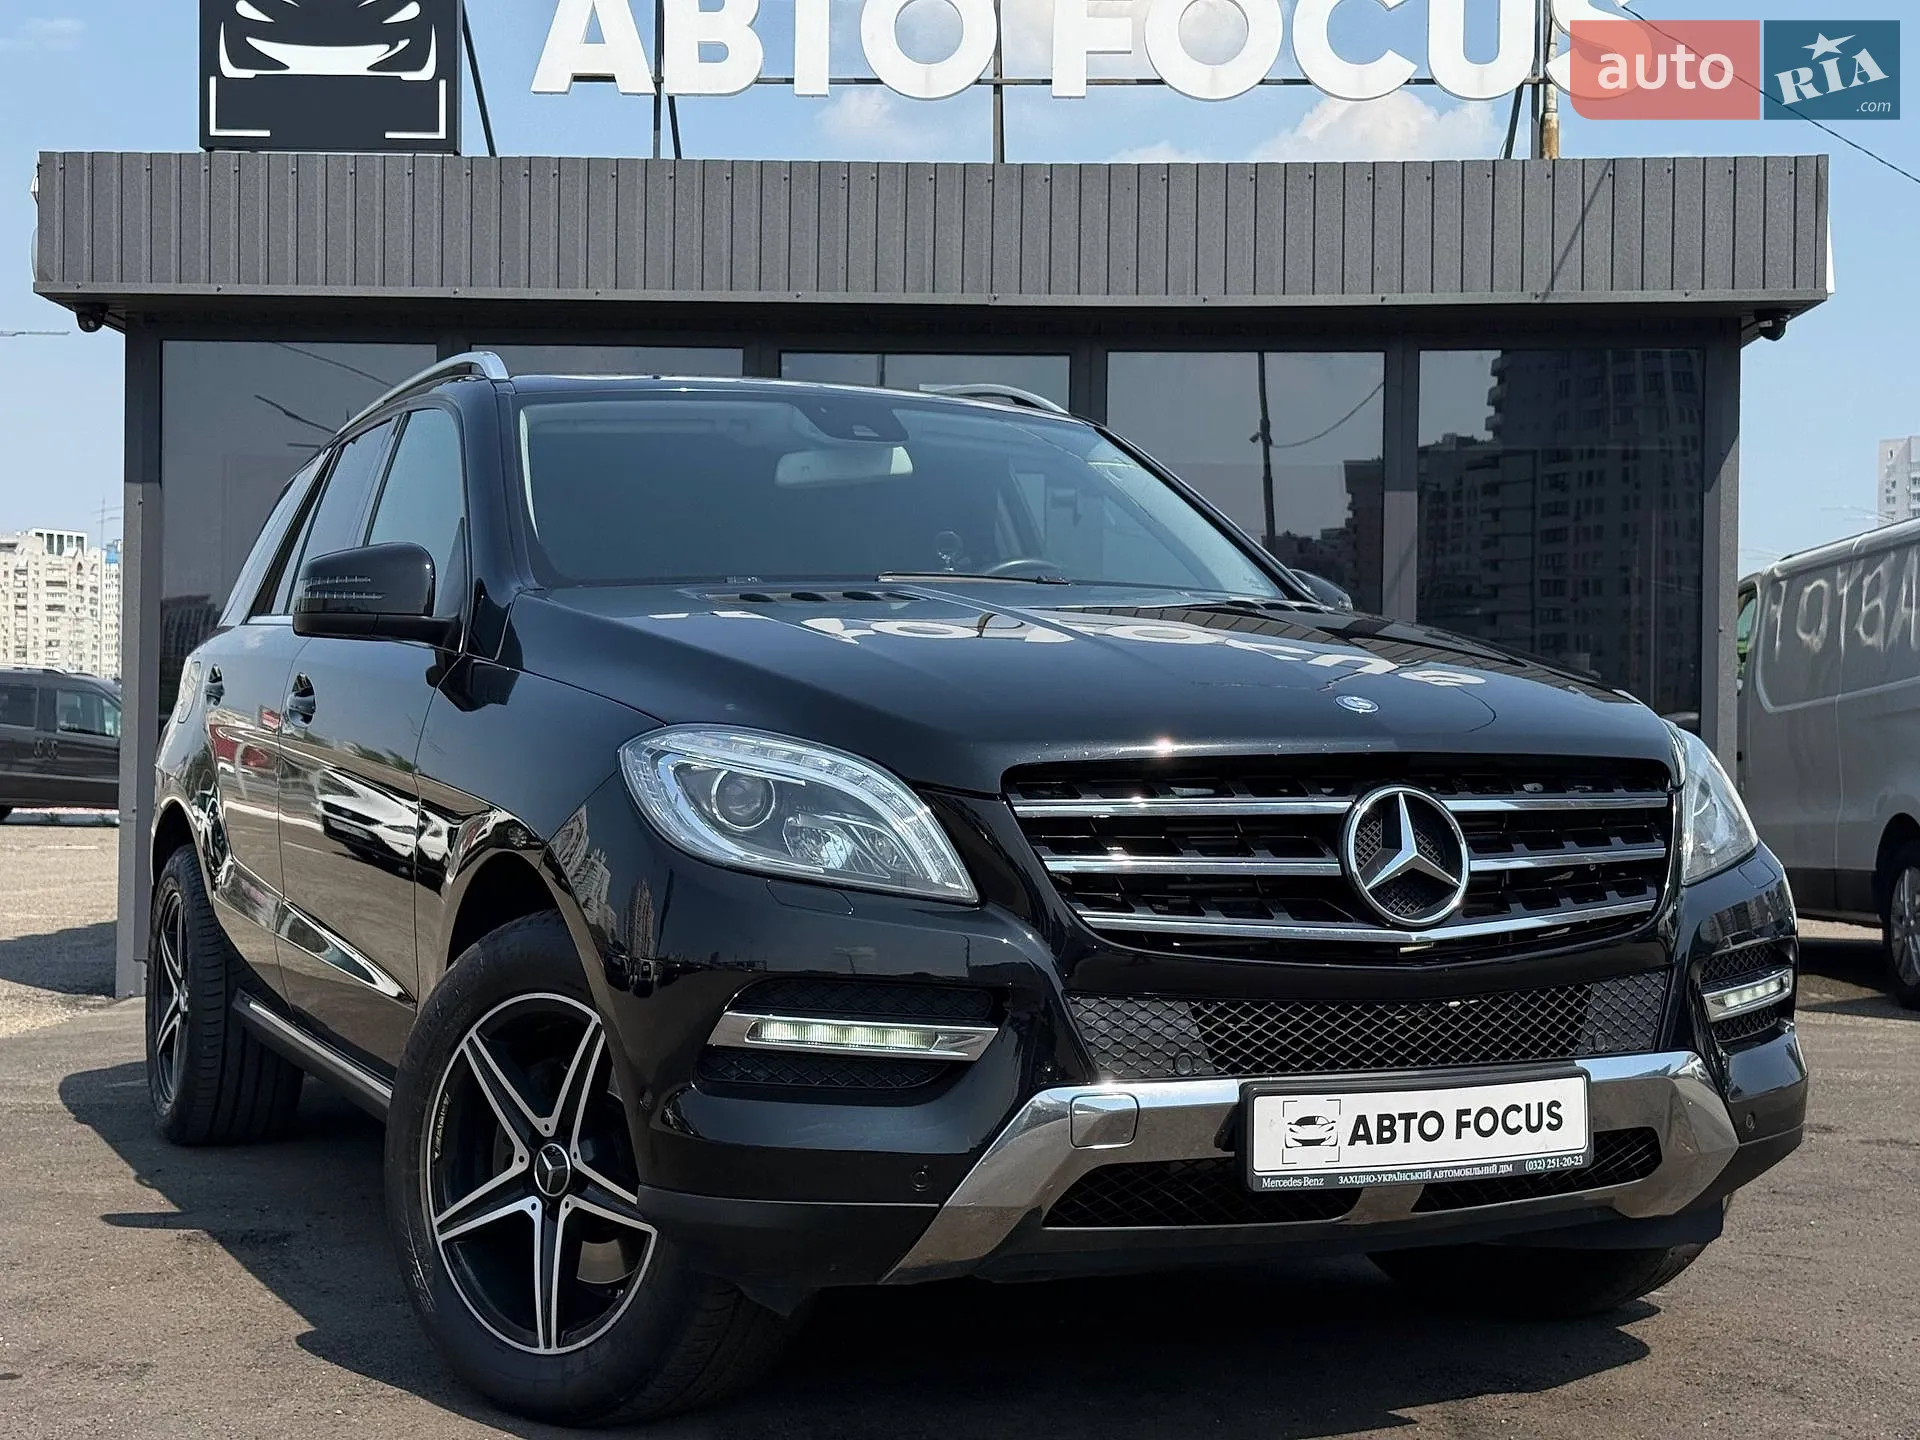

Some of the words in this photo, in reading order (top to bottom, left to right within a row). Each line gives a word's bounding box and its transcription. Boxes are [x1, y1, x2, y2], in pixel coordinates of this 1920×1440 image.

[1347, 1110, 1445, 1147] АВТО
[1455, 1099, 1564, 1140] FOCUS
[1525, 1159, 1546, 1172] (032)
[1547, 1154, 1584, 1170] 251-20-23
